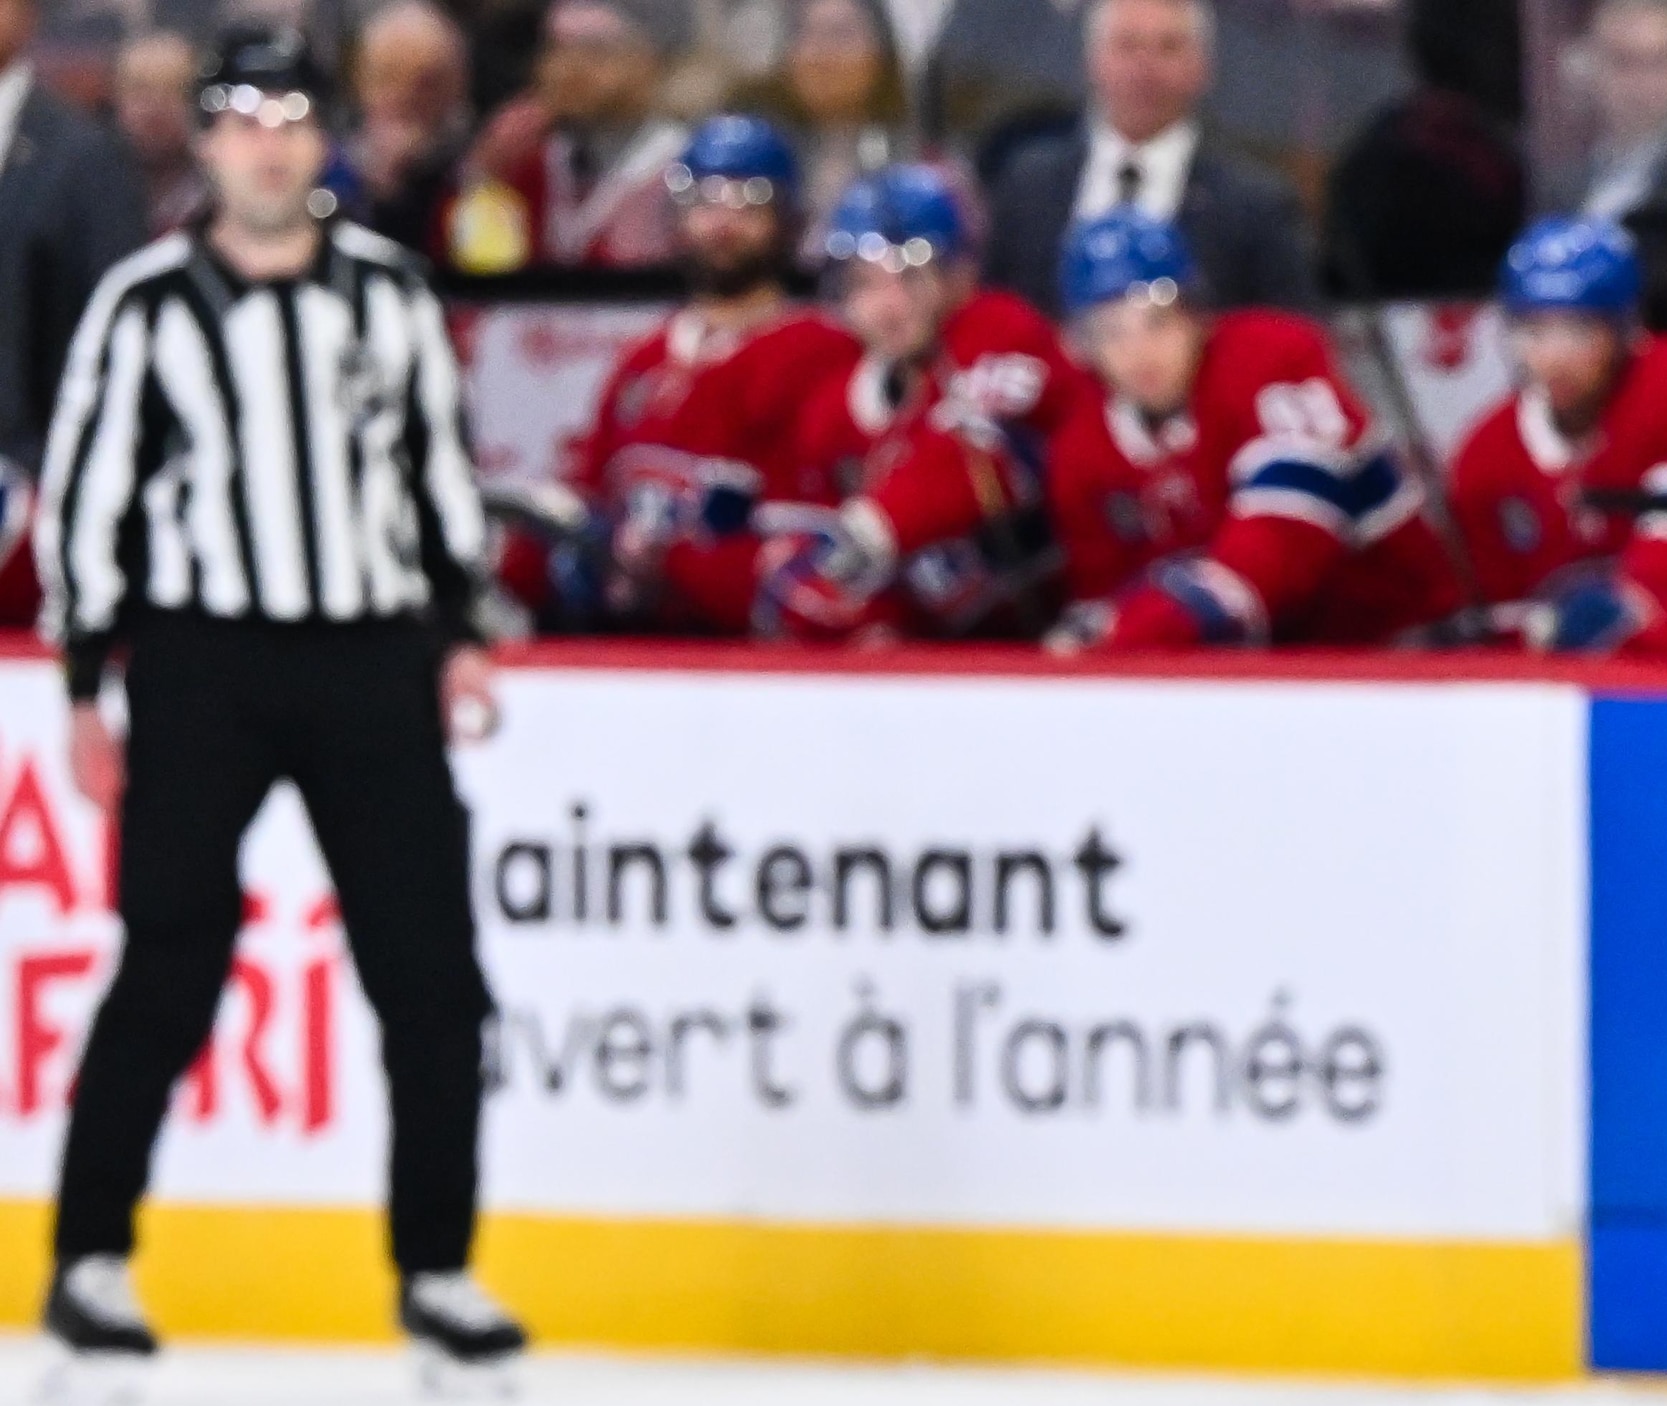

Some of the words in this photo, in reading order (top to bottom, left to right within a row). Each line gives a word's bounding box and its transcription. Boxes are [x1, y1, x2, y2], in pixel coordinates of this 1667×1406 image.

[493, 803, 1130, 940] aintenant
[0, 952, 333, 1140] FRI
[480, 986, 798, 1108] vert
[833, 974, 908, 1110] à
[952, 977, 1386, 1120] l'année
